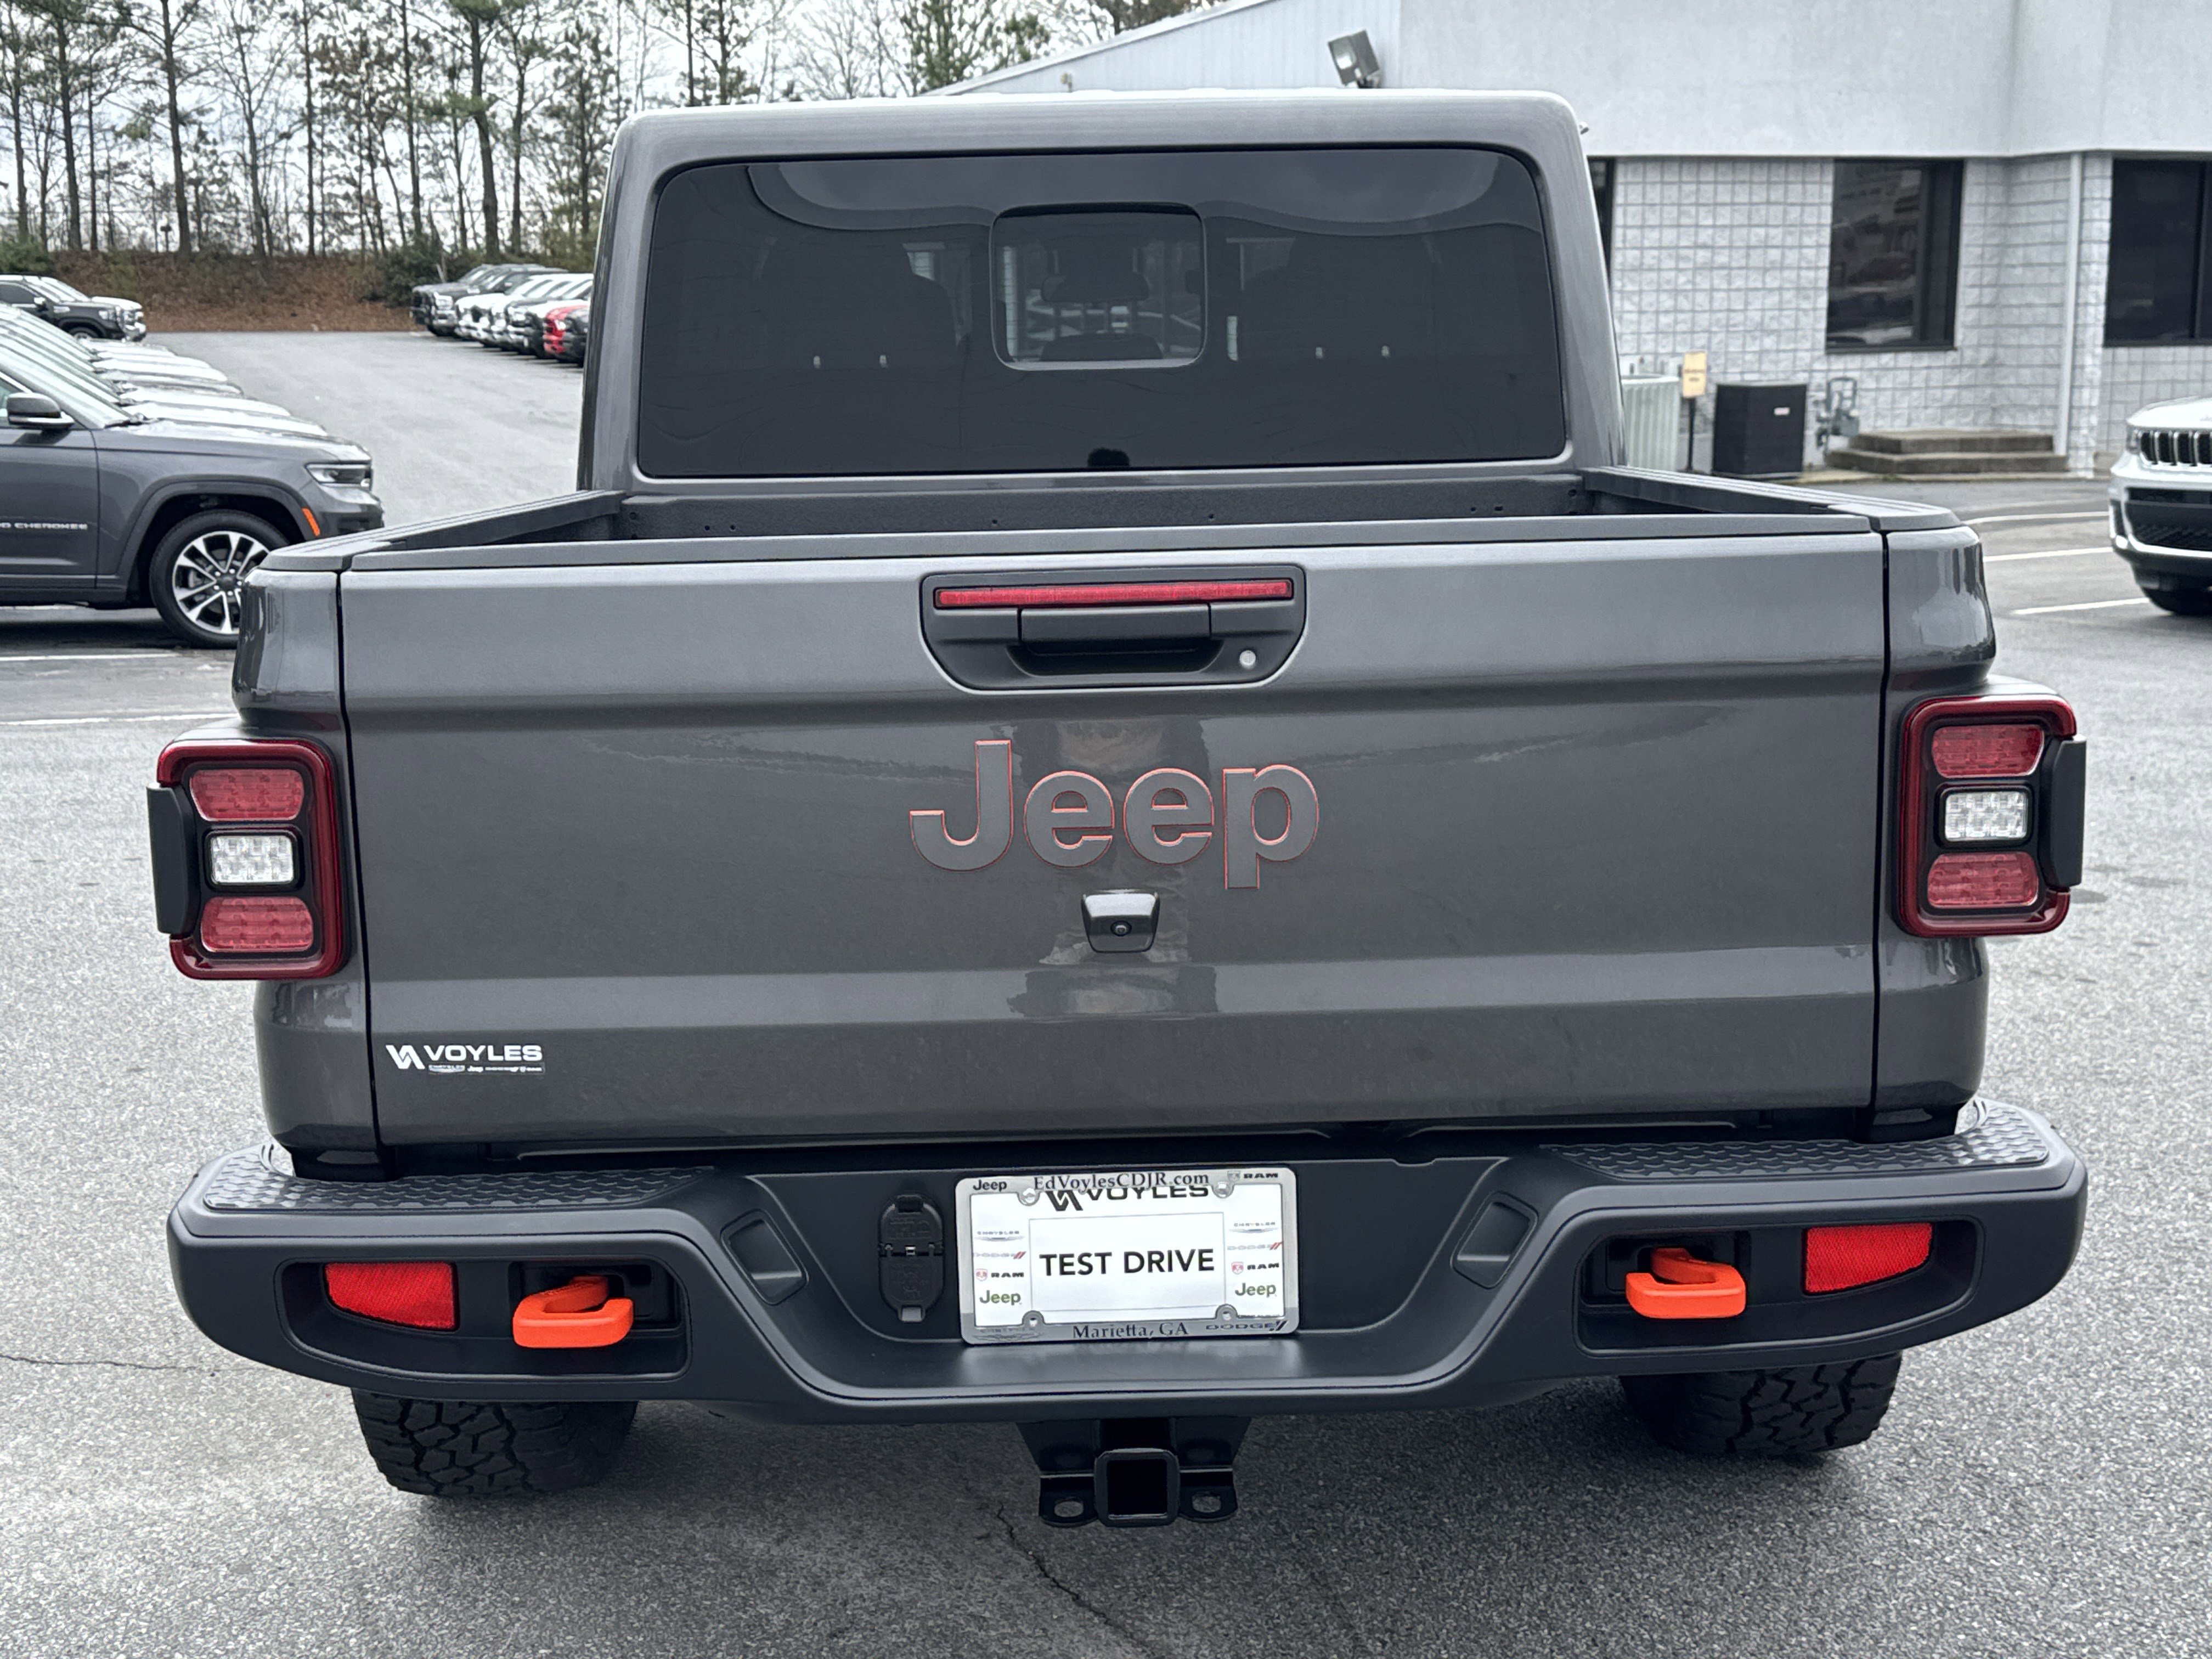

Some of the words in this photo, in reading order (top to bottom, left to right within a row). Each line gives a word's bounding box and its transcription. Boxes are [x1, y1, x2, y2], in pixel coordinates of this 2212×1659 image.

[910, 739, 1319, 890] Jeep
[424, 1045, 543, 1062] VOYLES
[973, 1179, 1007, 1192] Jeep
[1034, 1172, 1209, 1194] EdVoylesCDJR.com
[1087, 1184, 1209, 1201] VOYLES
[1039, 1252, 1113, 1276] TEST
[1124, 1248, 1215, 1274] DRIVE
[979, 1290, 1022, 1306] Jeep
[1235, 1282, 1277, 1298] Jeep
[1073, 1323, 1155, 1339] Marietta,
[1159, 1322, 1189, 1336] GA
